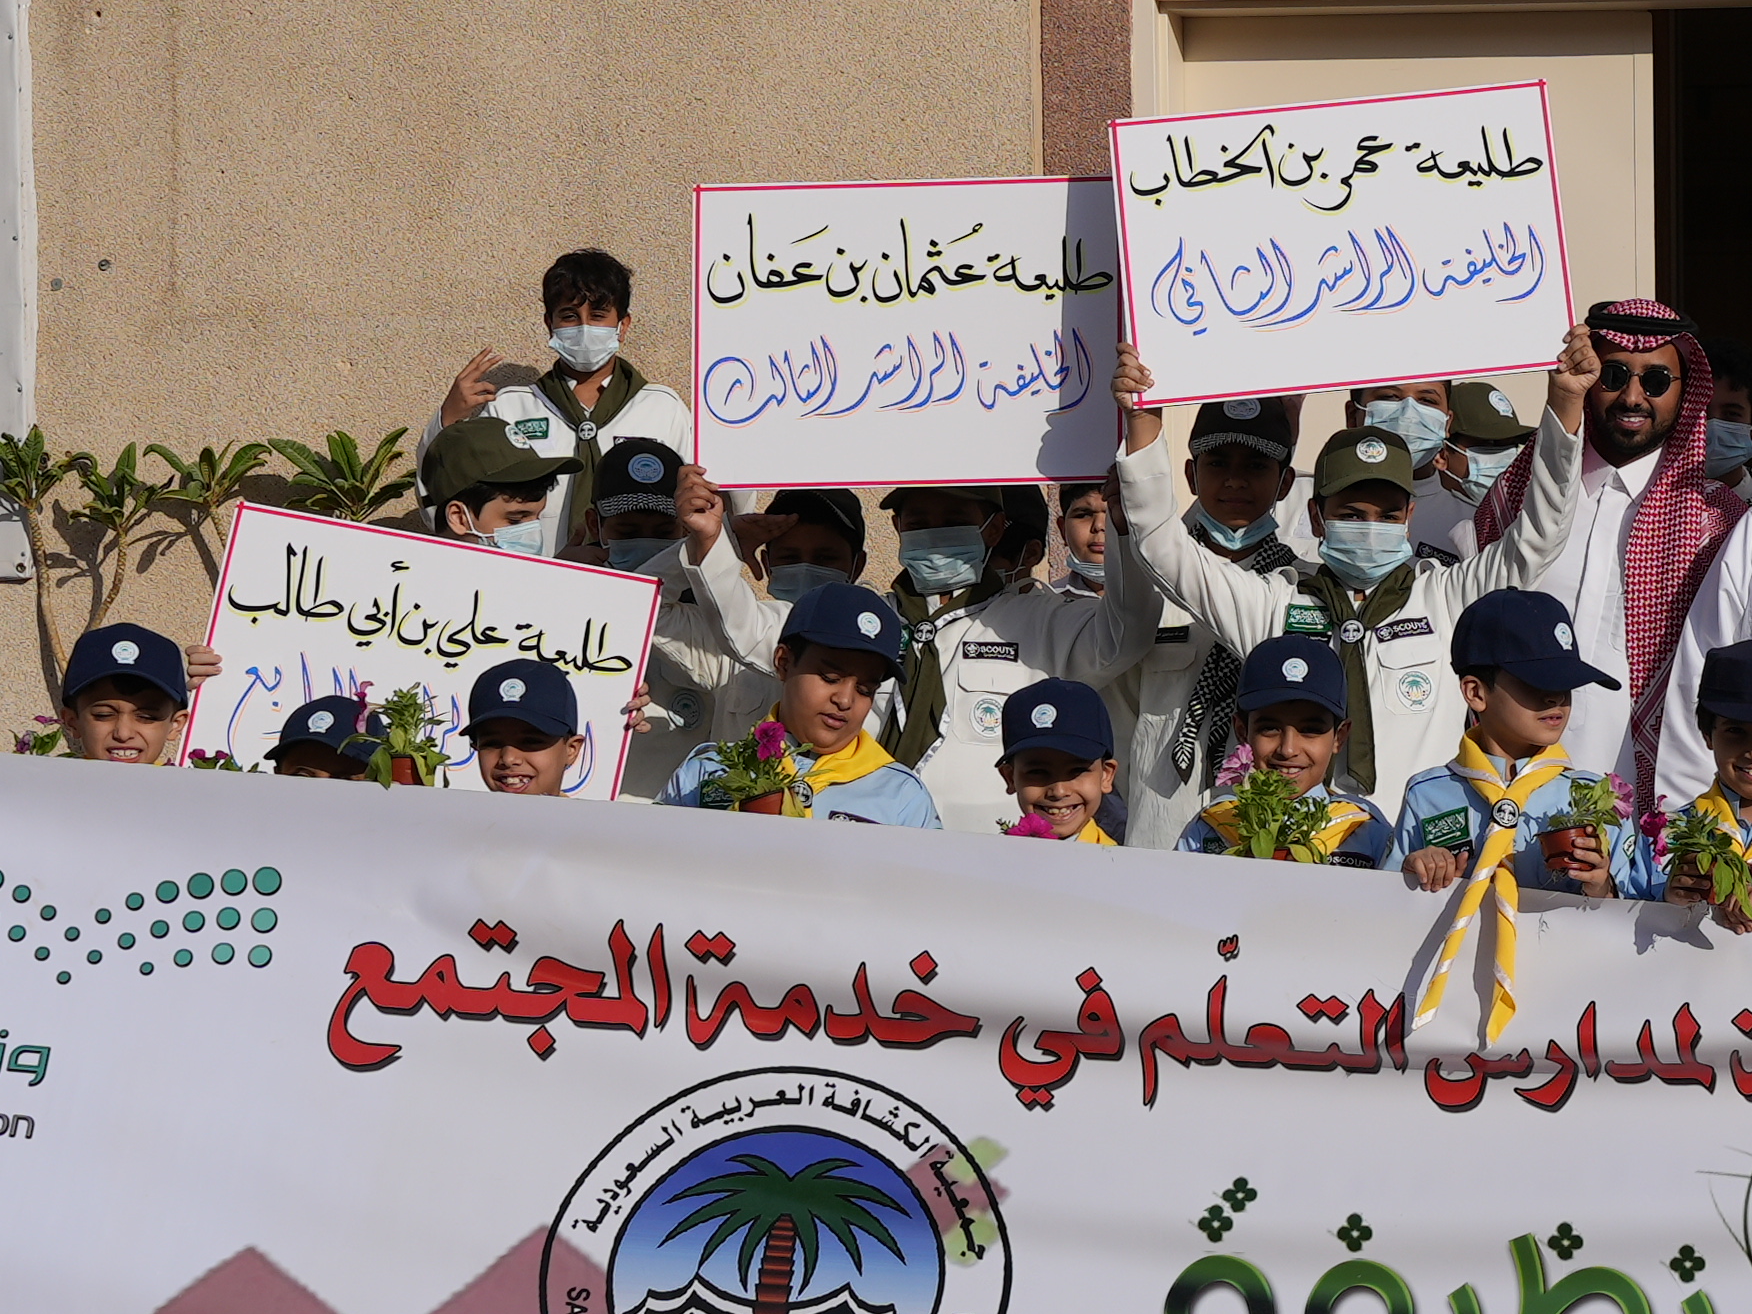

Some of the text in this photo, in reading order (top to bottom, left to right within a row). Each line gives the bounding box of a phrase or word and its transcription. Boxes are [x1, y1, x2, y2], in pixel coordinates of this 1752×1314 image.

[327, 919, 672, 1070] المجتمع
[686, 929, 979, 1047] خدمة
[999, 965, 1126, 1109] في
[1425, 1000, 1715, 1110] لمدارس
